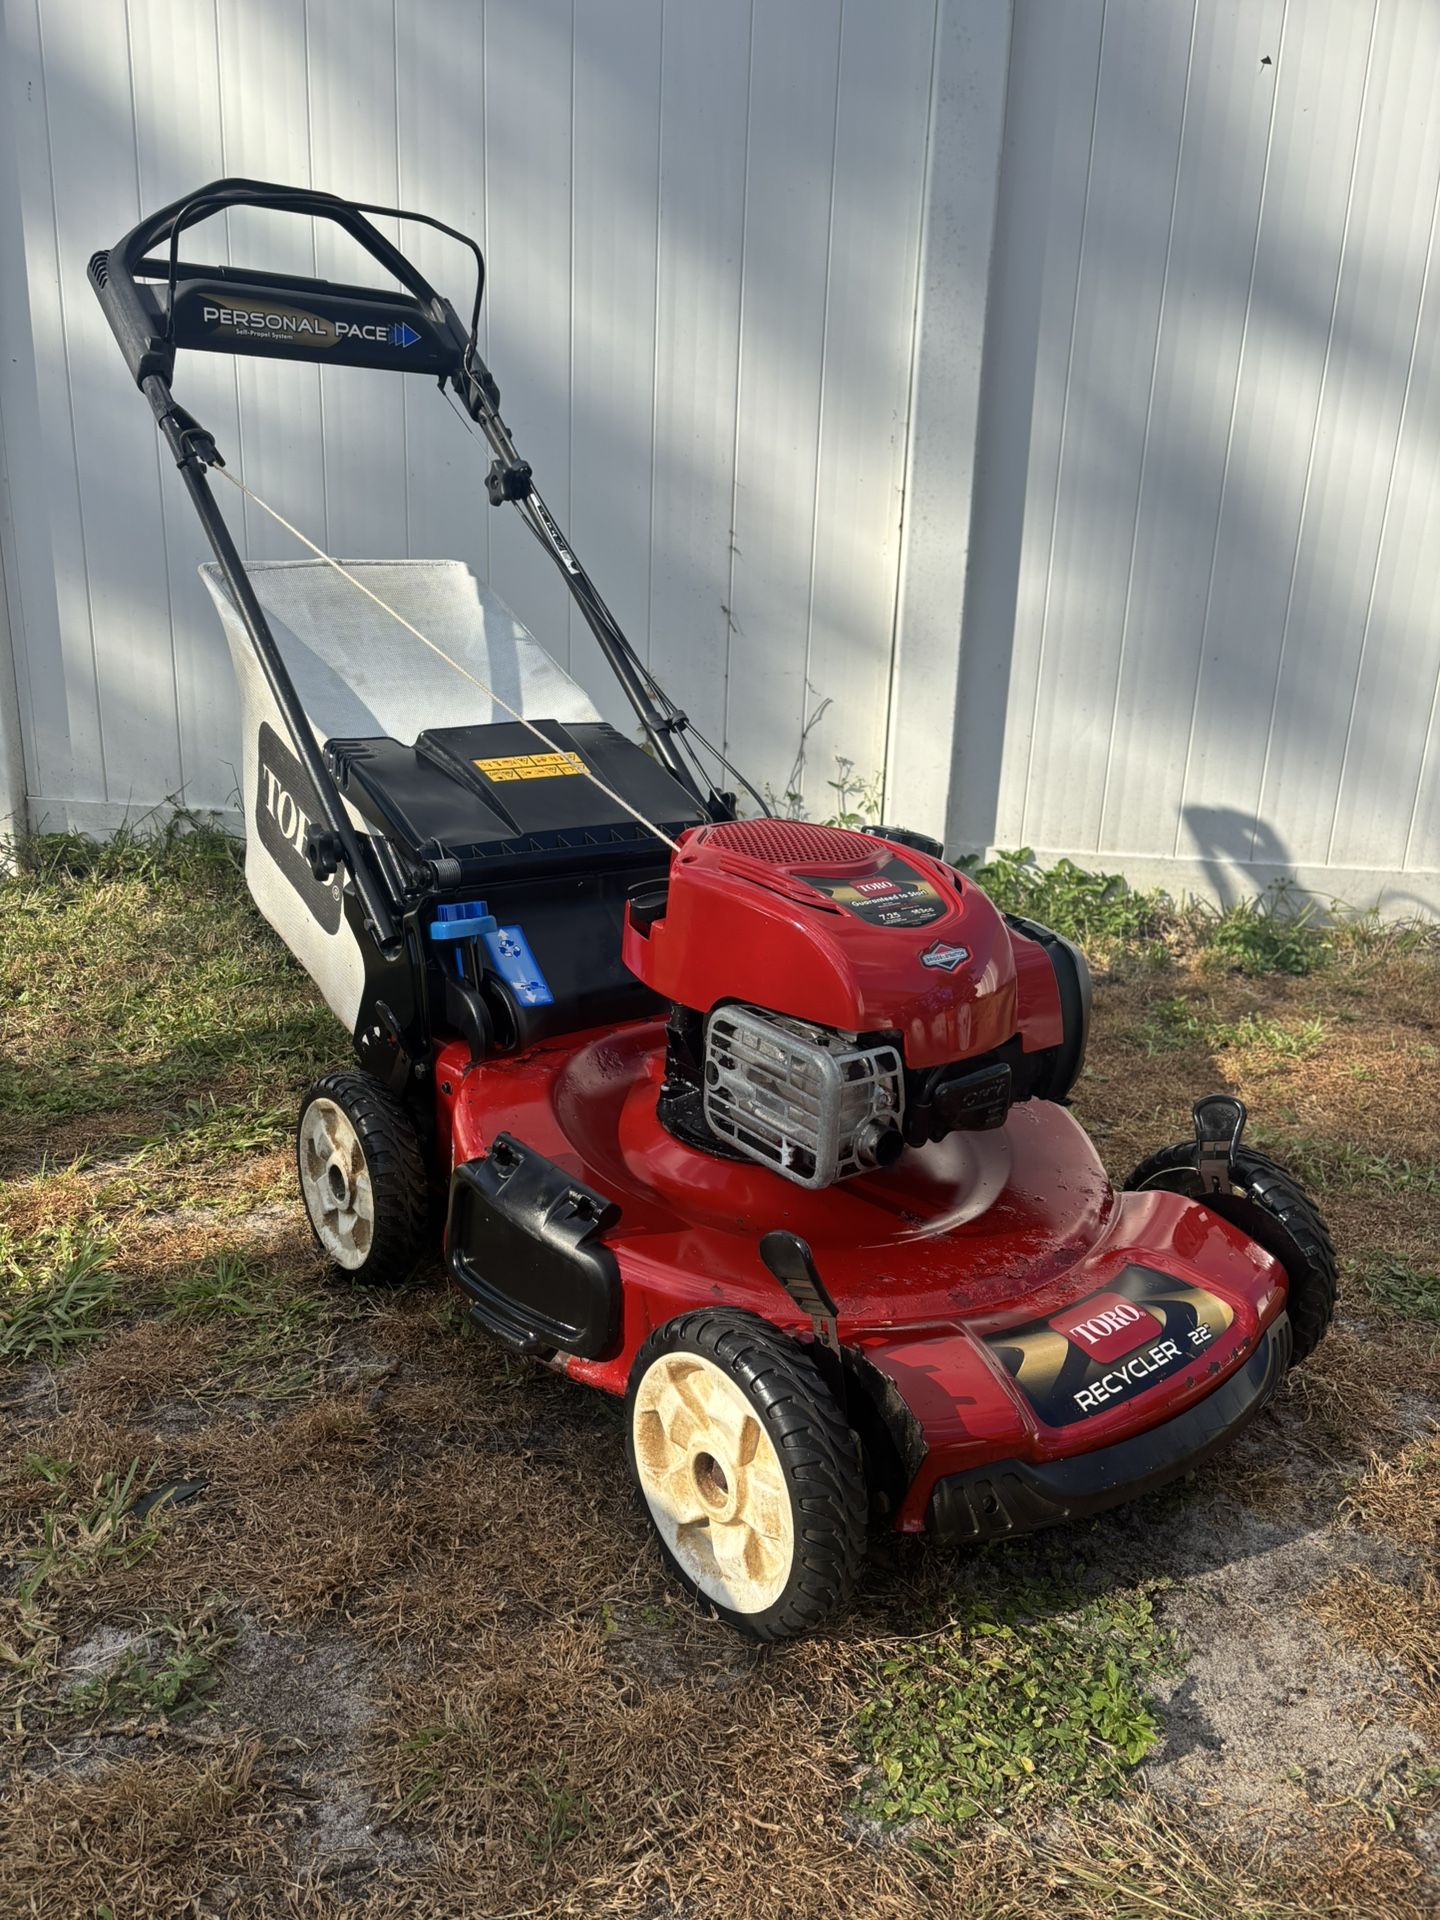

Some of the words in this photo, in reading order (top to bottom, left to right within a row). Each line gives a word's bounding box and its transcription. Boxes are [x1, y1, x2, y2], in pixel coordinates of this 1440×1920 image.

[203, 307, 326, 335] PERSONAL
[335, 321, 388, 341] PACE
[271, 330, 294, 340] System
[857, 881, 893, 892] TORO
[851, 894, 899, 906] Guaranteed
[879, 911, 901, 921] 7.25
[1069, 1304, 1140, 1345] TORO
[1073, 1340, 1183, 1412] RECYCLER
